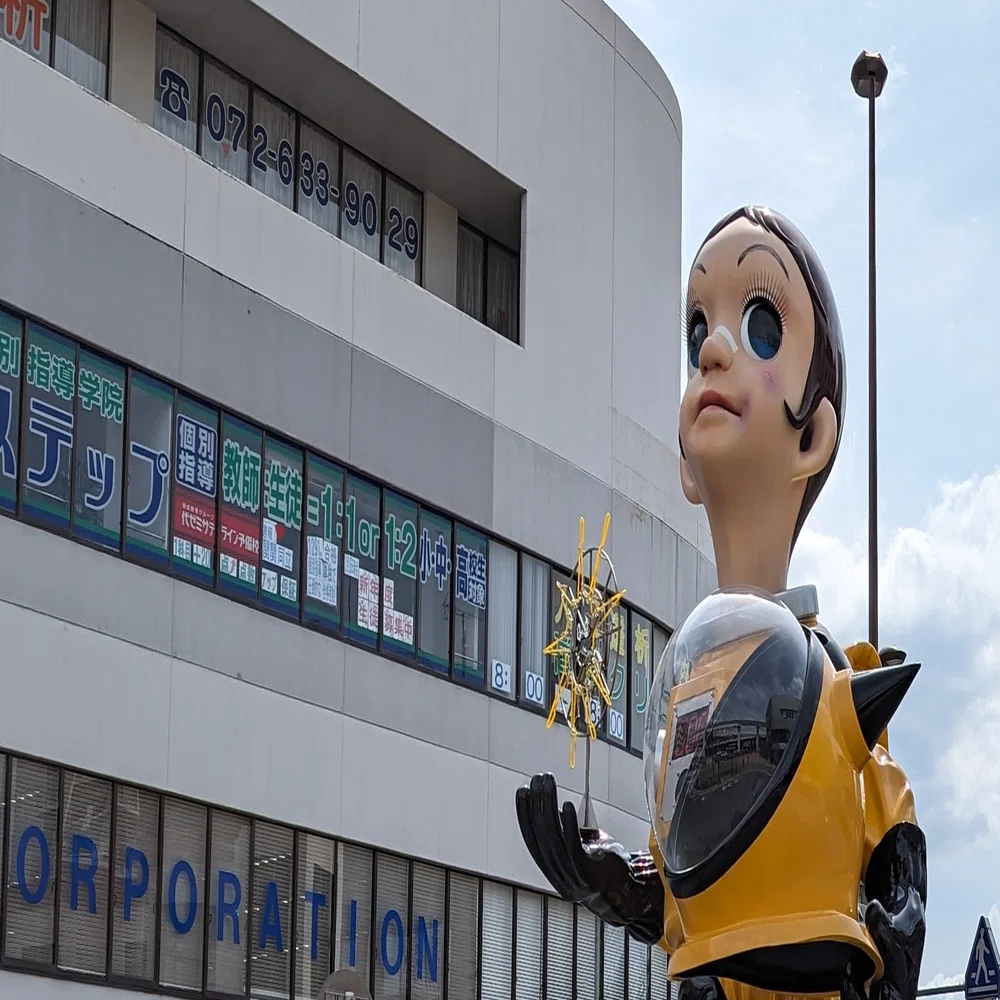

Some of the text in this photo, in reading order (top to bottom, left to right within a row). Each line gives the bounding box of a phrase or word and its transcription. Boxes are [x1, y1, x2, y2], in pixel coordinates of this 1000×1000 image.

[205, 92, 420, 261] 072-633-9029
[178, 420, 216, 460] 個別
[178, 453, 215, 493] 指導
[16, 825, 439, 982] ORPORATION
